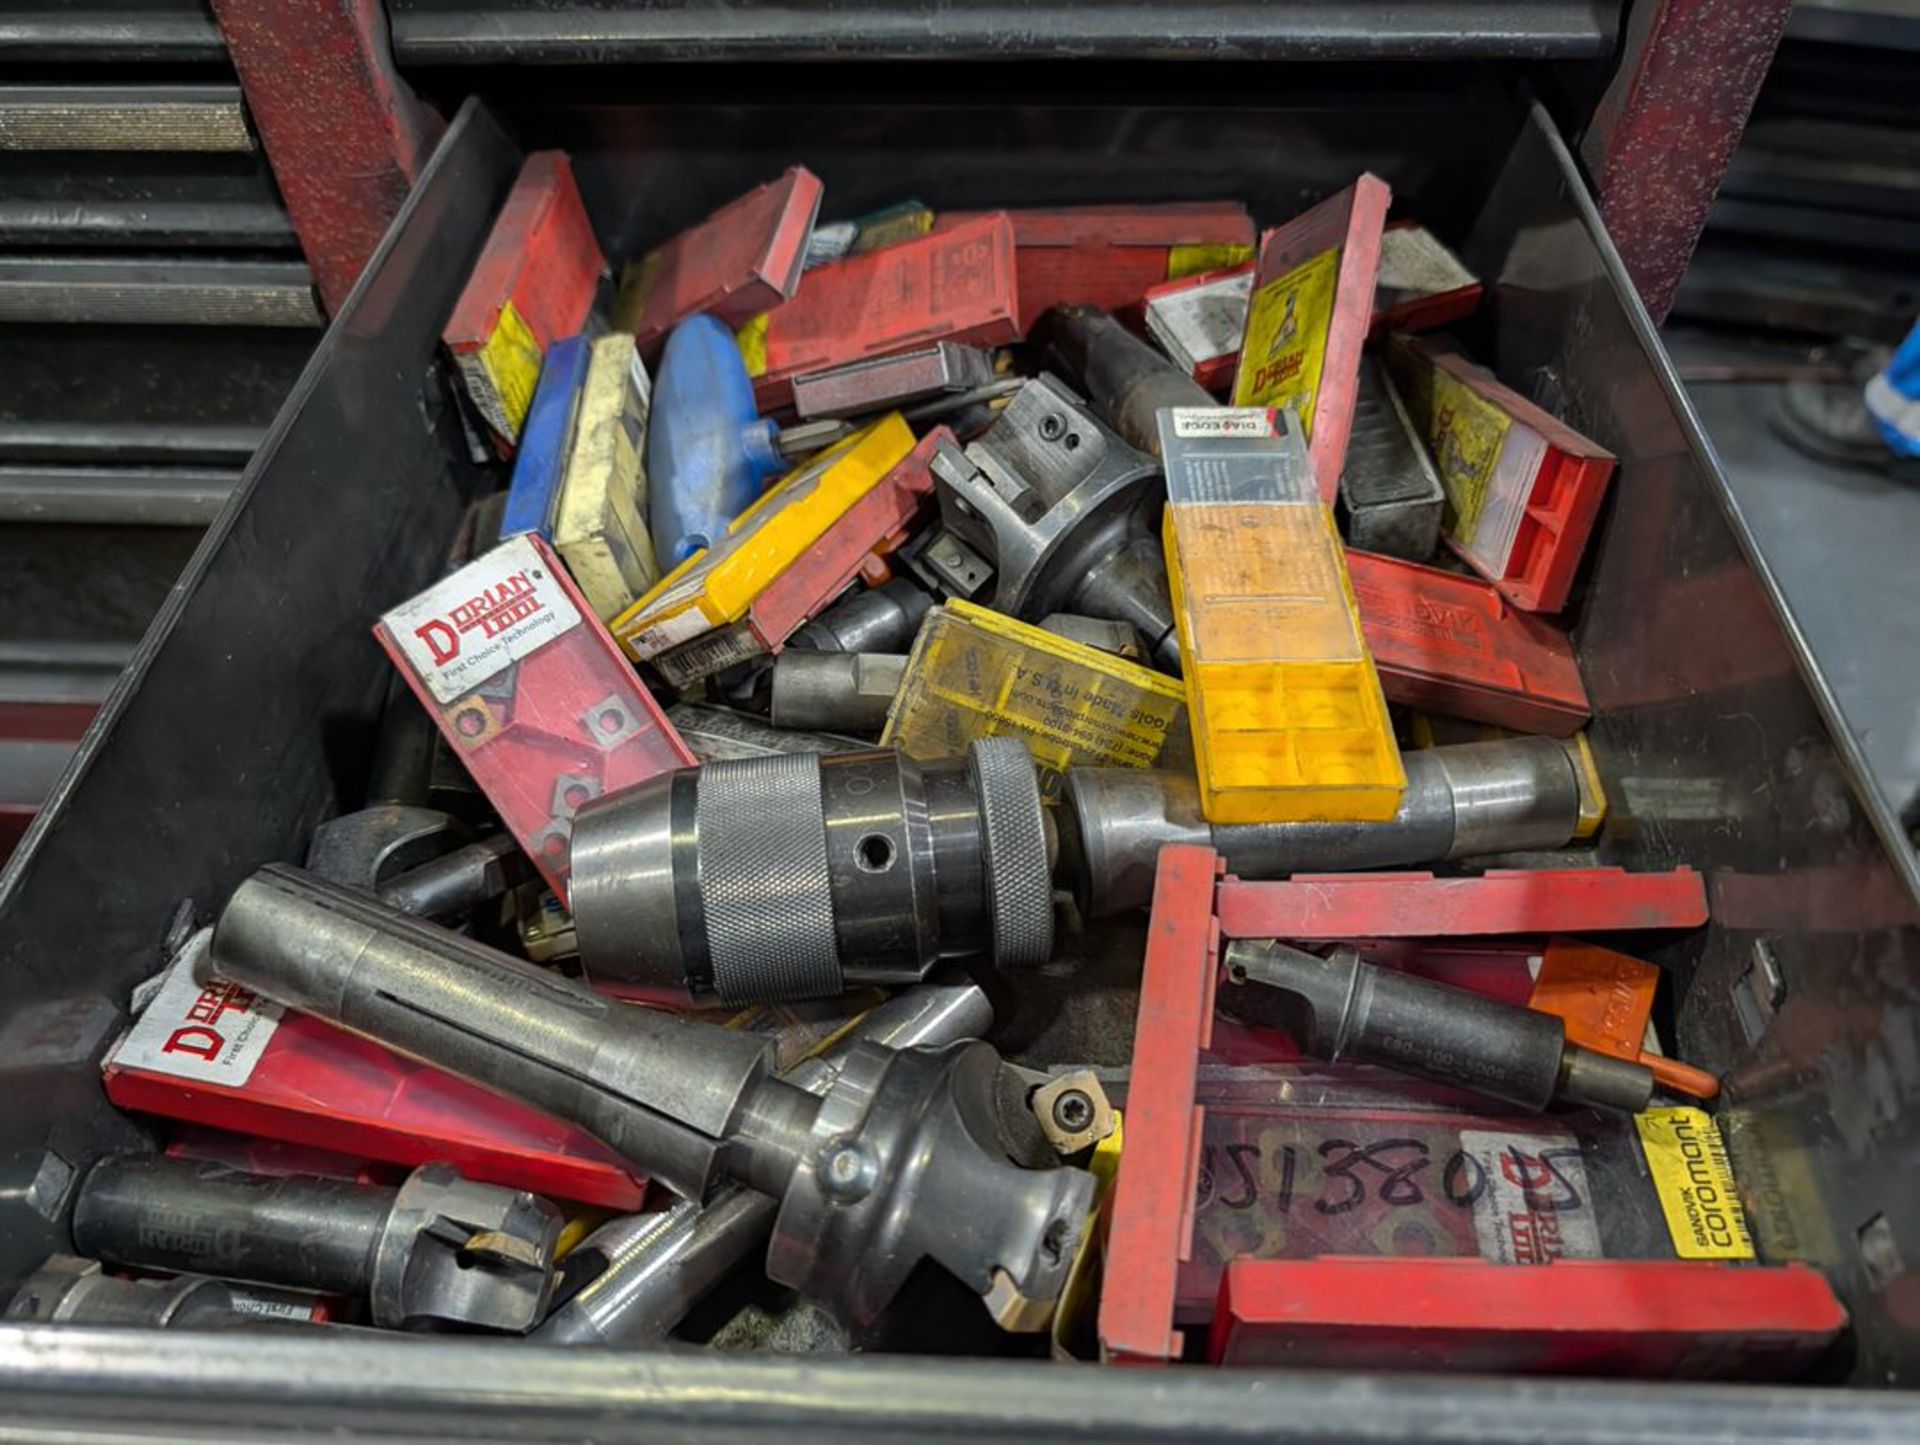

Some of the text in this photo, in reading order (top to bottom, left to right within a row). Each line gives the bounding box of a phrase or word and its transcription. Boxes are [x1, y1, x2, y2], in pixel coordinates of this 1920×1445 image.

[414, 570, 538, 667] DORIAN
[443, 610, 557, 681] First Choice Technology
[477, 595, 547, 640] TOOL
[222, 1039, 246, 1067] First
[1668, 1115, 1733, 1248] coromant
[1680, 1186, 1711, 1248] SANDVIK
